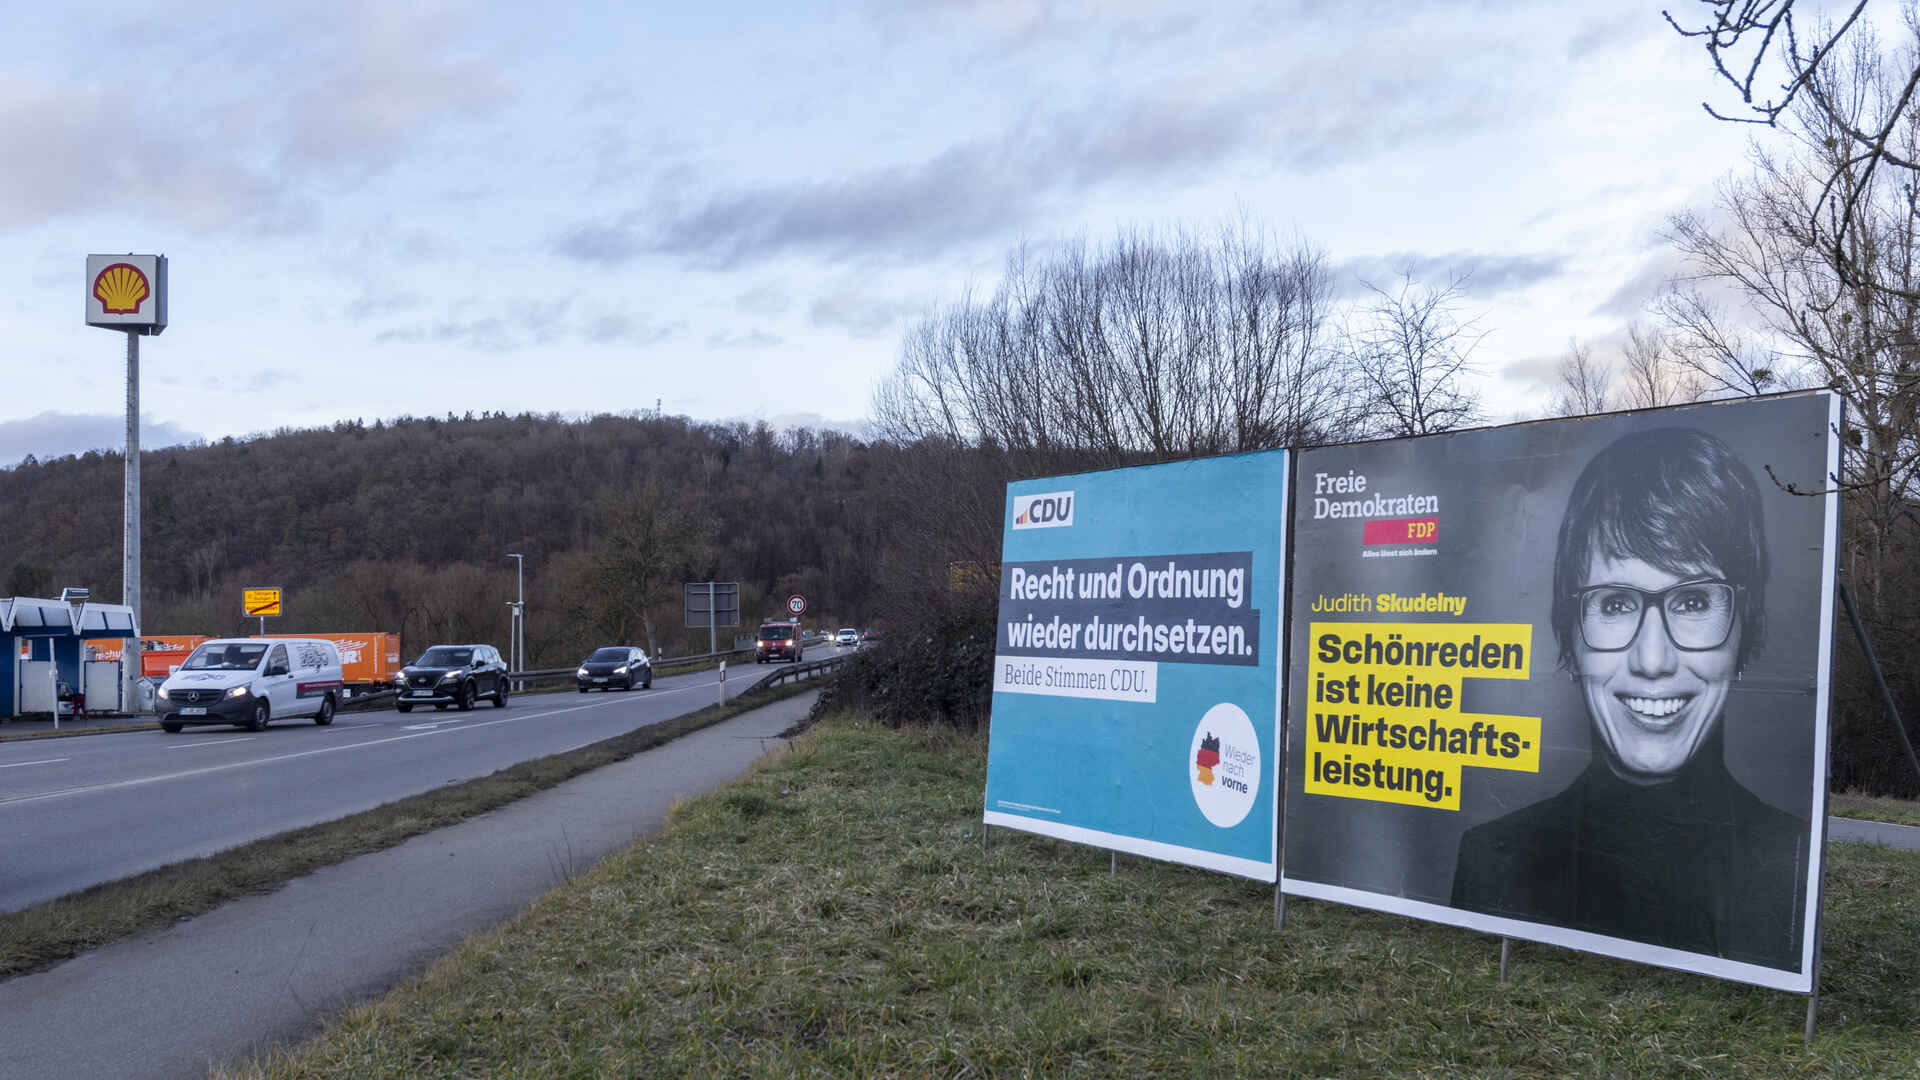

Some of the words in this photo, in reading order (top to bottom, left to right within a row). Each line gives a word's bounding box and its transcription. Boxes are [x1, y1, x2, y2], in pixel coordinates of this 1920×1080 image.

[1314, 470, 1367, 495] Freie
[1029, 497, 1071, 523] CDU
[1313, 493, 1439, 519] Demokraten
[1407, 522, 1436, 539] FDP
[1010, 566, 1075, 600] Recht
[1079, 564, 1123, 599] und
[1127, 562, 1245, 608] Ordnung
[1311, 594, 1372, 612] Judith
[1376, 592, 1467, 616] Skudelny
[1007, 613, 1082, 649] wieder
[1084, 615, 1252, 656] durchsetzen.
[1317, 633, 1524, 670] Schönreden
[1004, 663, 1043, 687] Beide
[1044, 665, 1107, 691] Stimmen
[1110, 668, 1148, 693] CDU.
[1315, 672, 1360, 704] ist
[1367, 674, 1453, 709] keine
[1314, 713, 1531, 758] Wirtschafts-
[1224, 744, 1256, 765] Wieder
[1222, 761, 1245, 777] nach
[1313, 752, 1452, 802] leistung.
[1221, 776, 1248, 794] vorne
